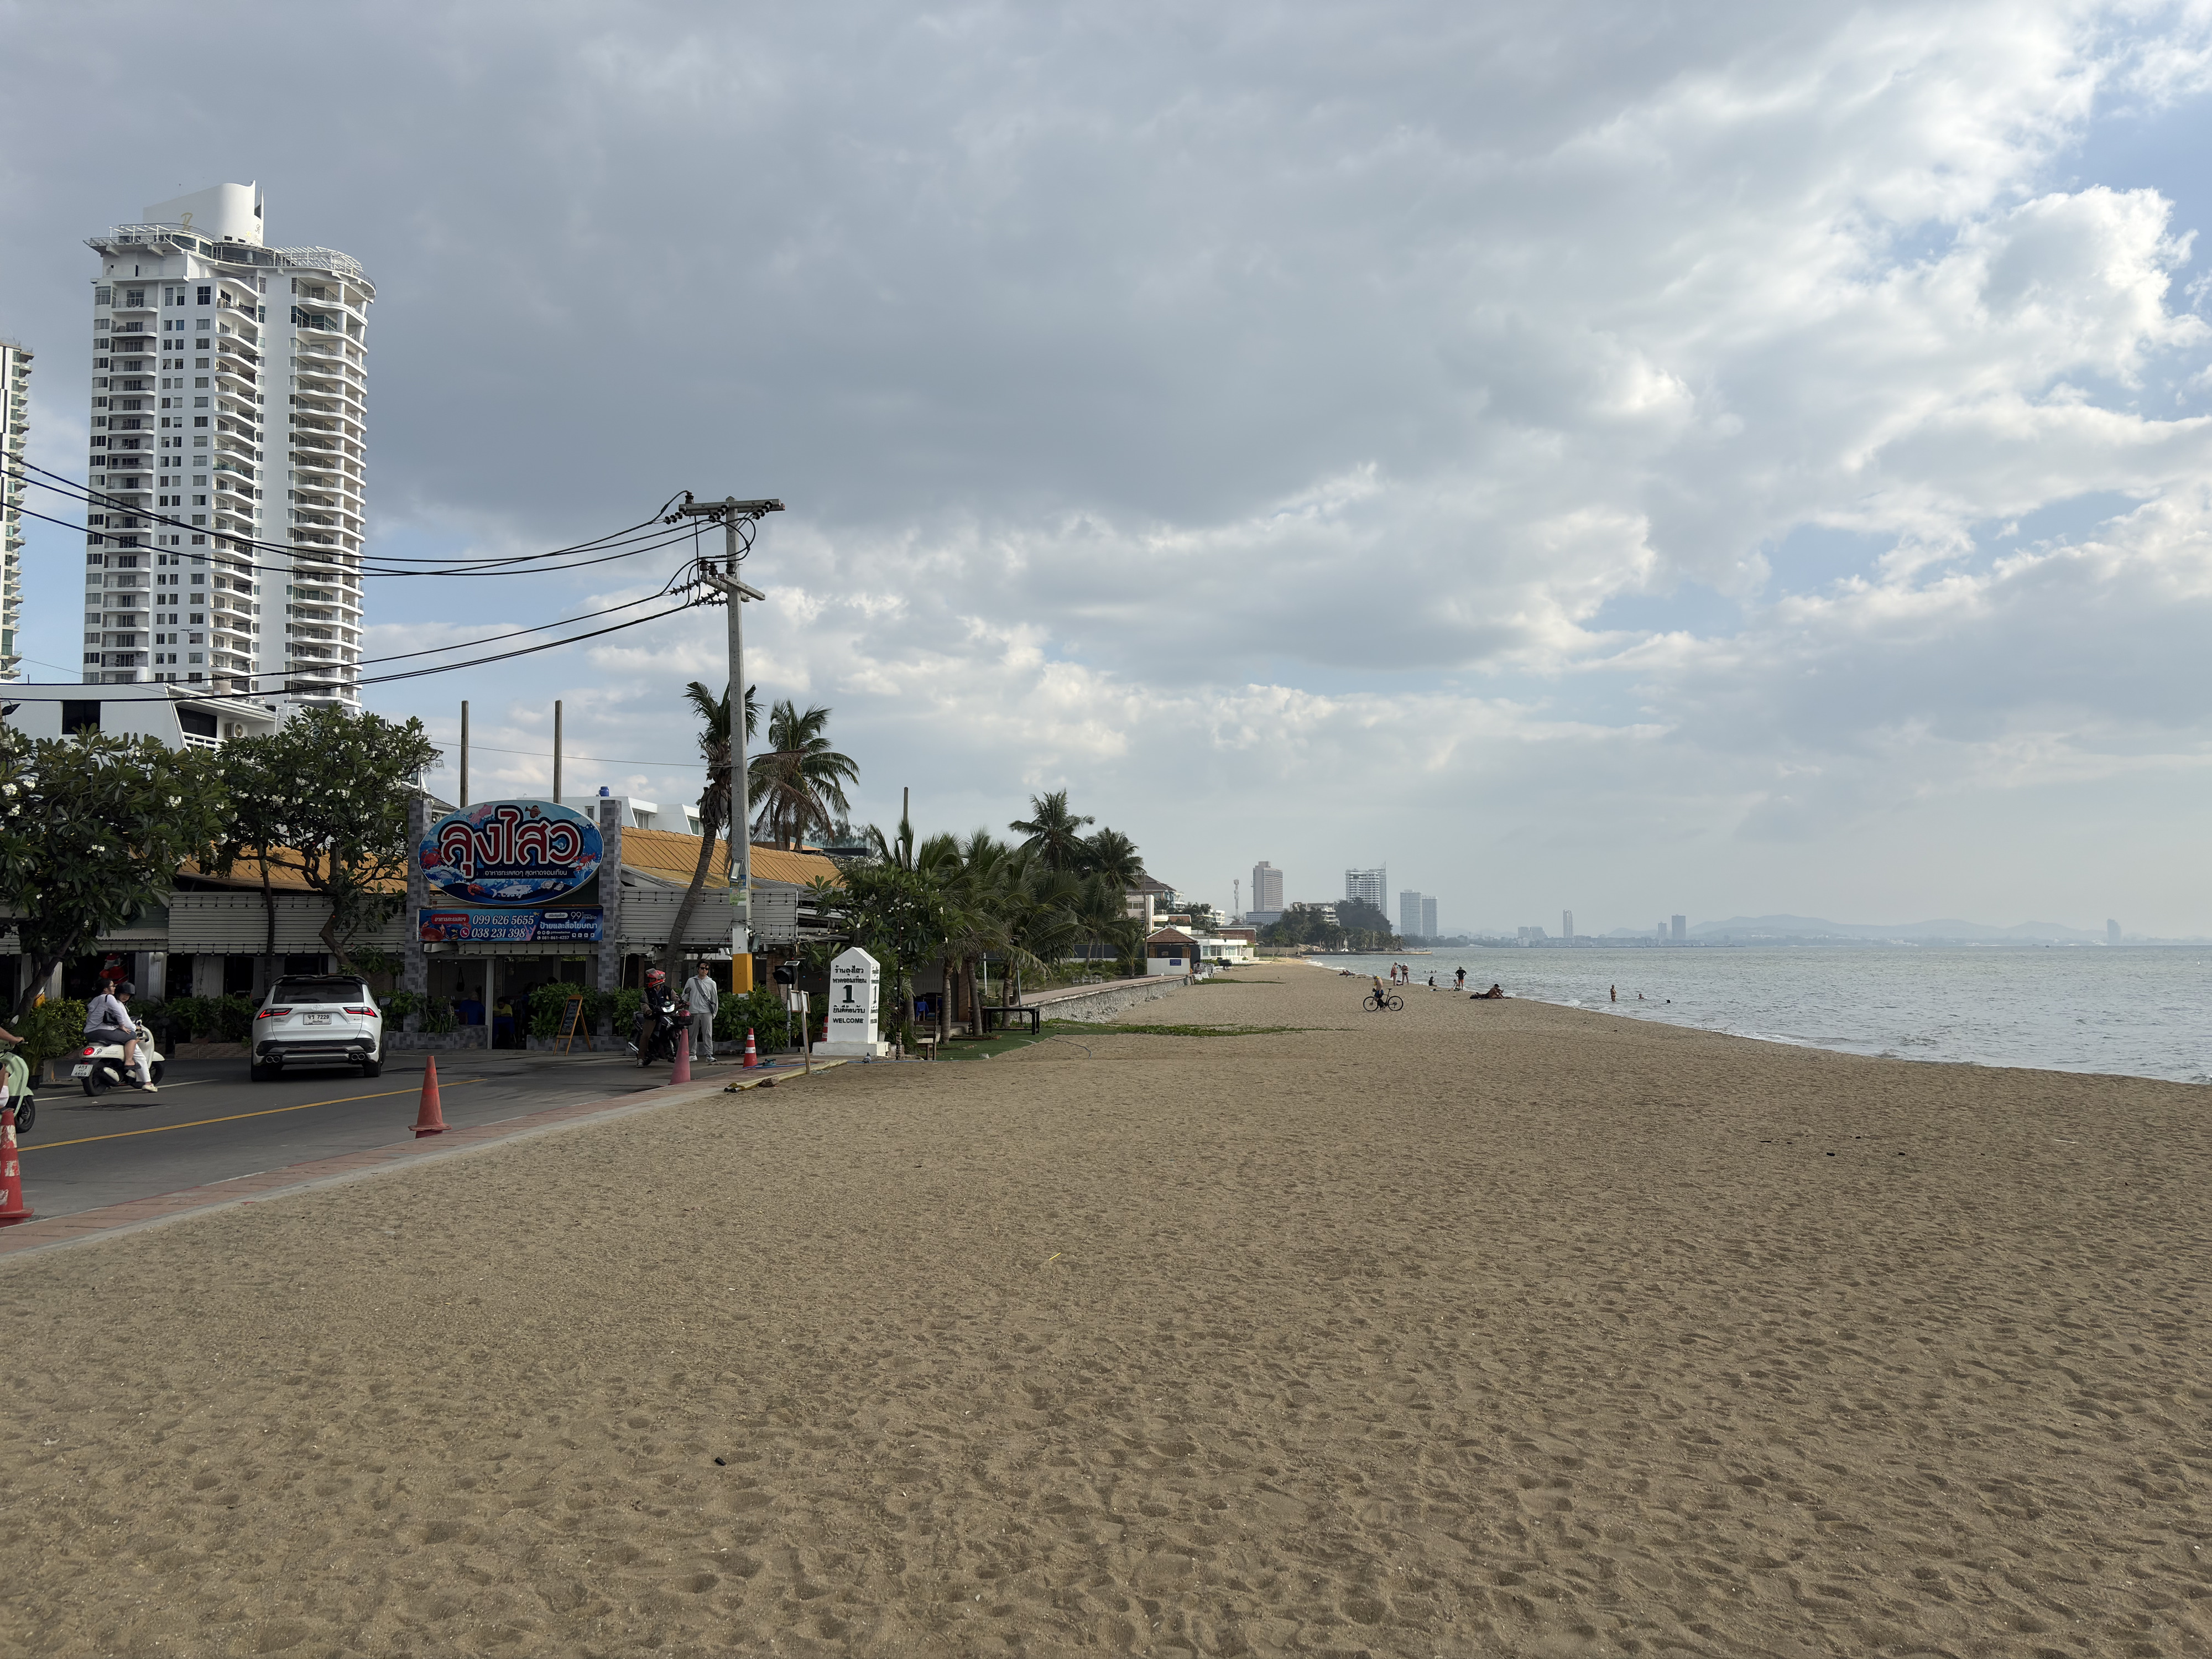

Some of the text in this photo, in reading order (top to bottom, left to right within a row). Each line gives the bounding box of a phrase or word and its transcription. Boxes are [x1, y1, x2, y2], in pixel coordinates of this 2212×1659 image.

[441, 808, 581, 879] ลุงไสว
[472, 915, 534, 925] 099 626 5655
[571, 911, 581, 920] 99
[540, 920, 597, 929] ป้ายและสื่อโฆษณา
[471, 928, 525, 938] 038 231 398
[834, 964, 864, 976] ร้านลุงไสว
[832, 975, 867, 983] หาดจอมเทียน
[842, 984, 855, 1003] 1
[833, 1005, 865, 1013] ยินดีต้อนรับ
